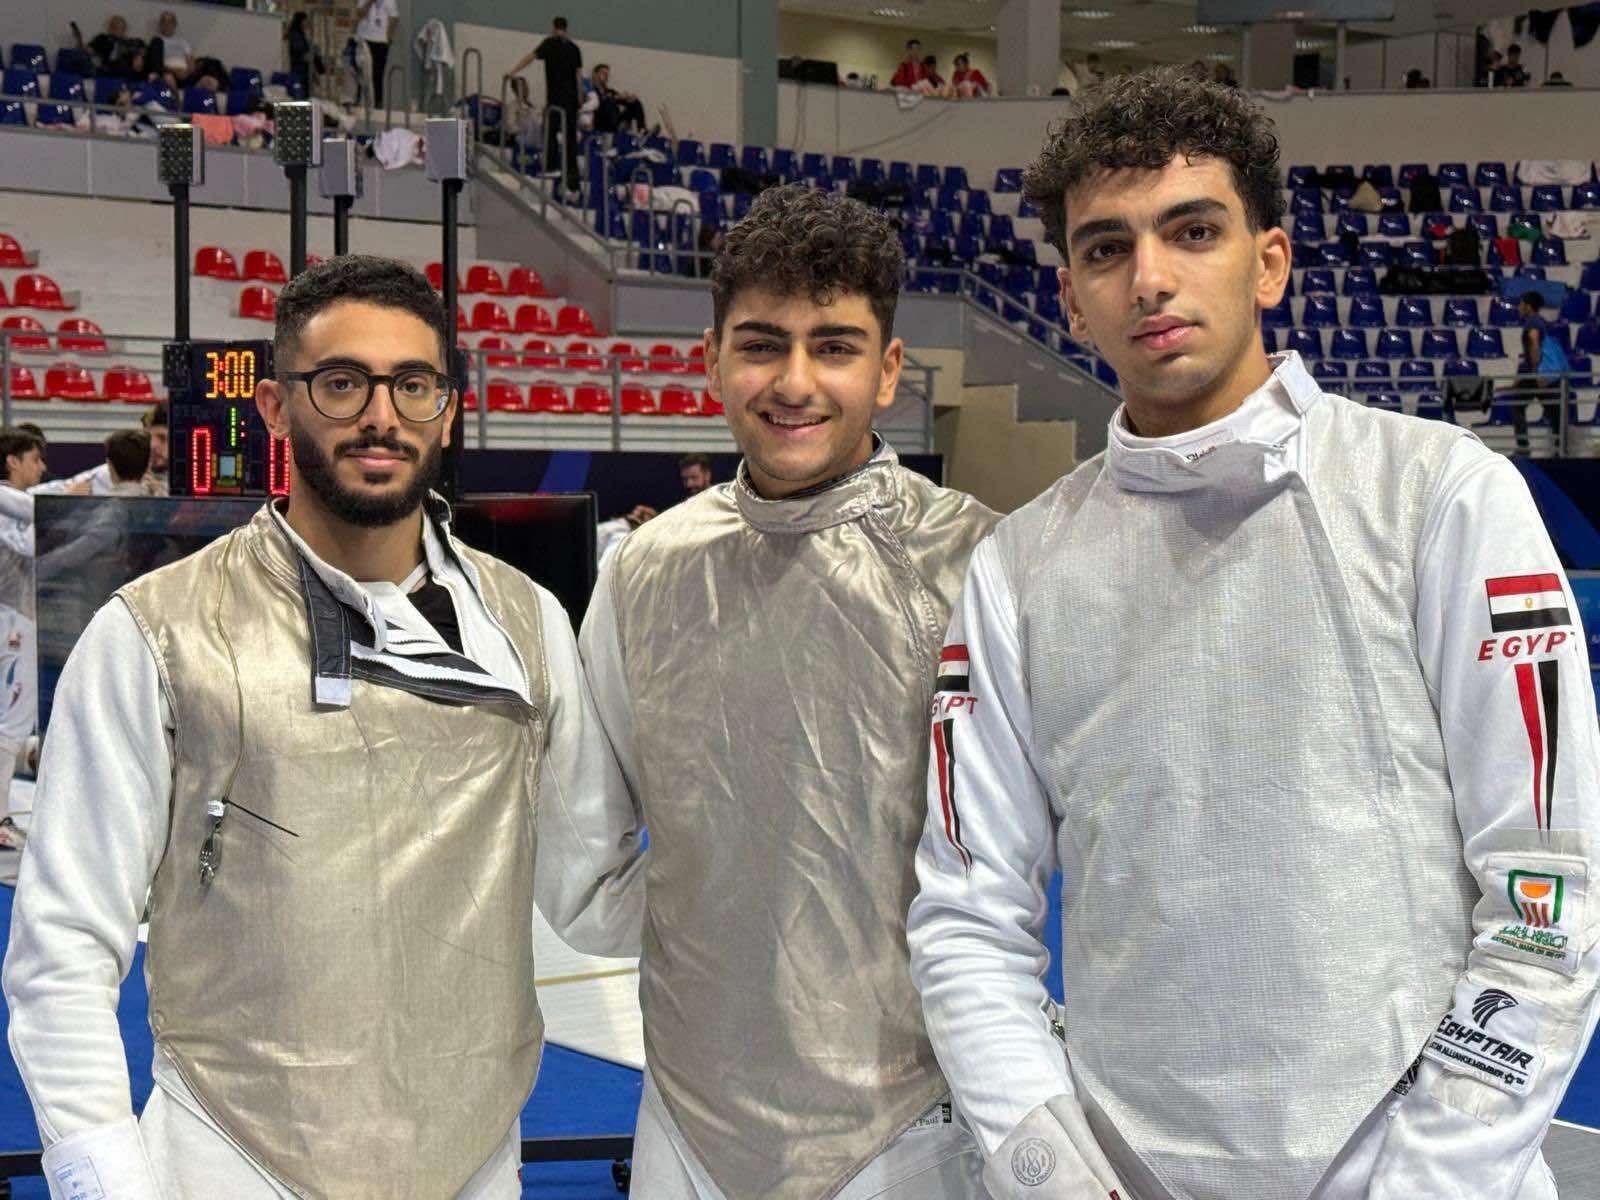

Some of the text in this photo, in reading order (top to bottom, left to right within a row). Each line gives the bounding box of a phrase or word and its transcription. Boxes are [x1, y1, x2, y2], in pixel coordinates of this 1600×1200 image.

[206, 351, 255, 398] 3:00
[192, 427, 211, 493] 0
[1437, 1014, 1534, 1069] EGYPTAIR
